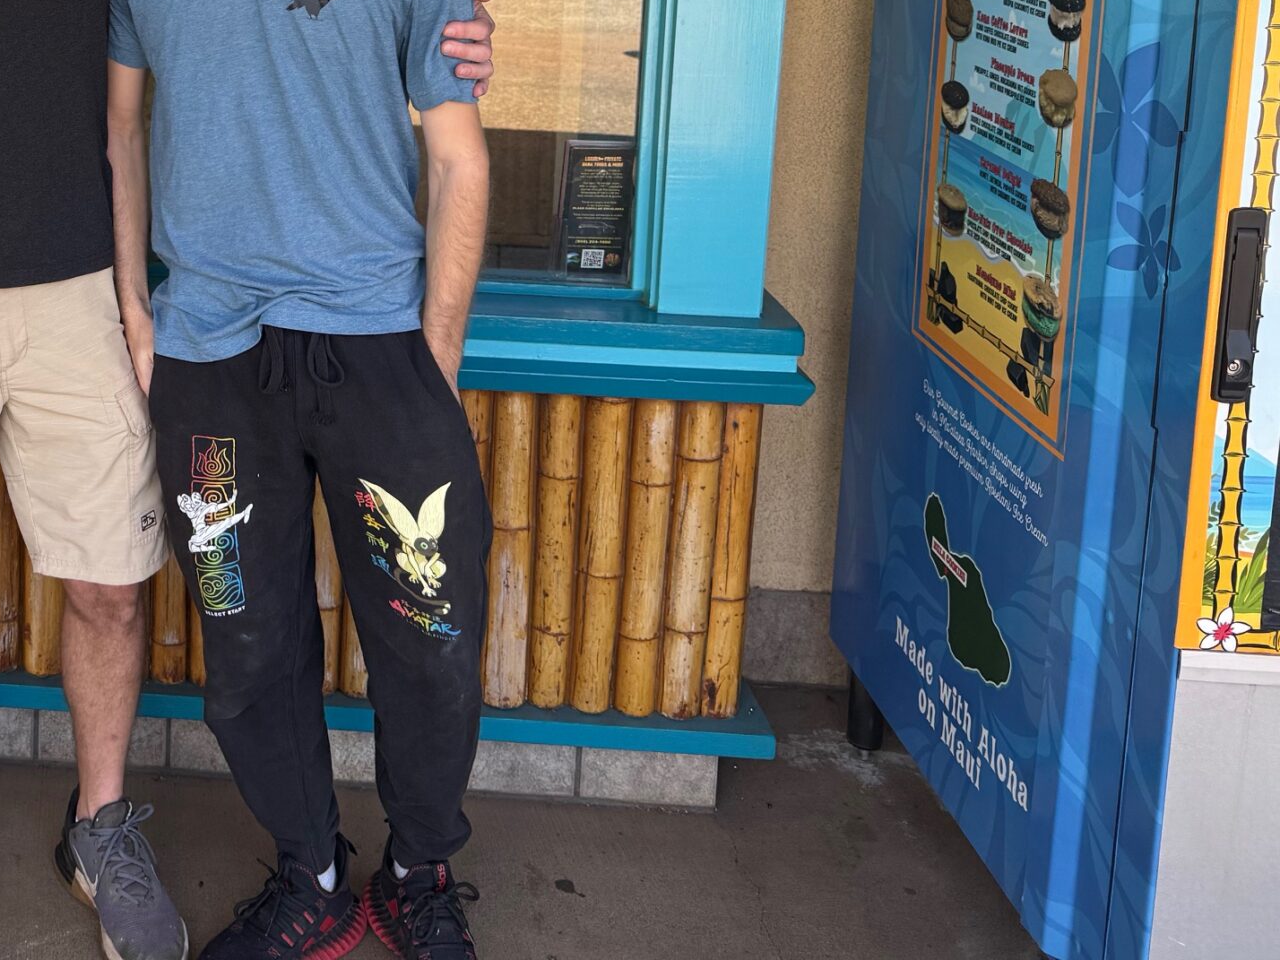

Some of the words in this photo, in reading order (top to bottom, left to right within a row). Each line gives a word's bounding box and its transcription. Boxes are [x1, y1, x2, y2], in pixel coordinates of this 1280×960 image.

[923, 379, 934, 398] Our
[936, 390, 959, 420] Gourmet
[960, 412, 980, 440] Cookies
[981, 435, 992, 451] are
[992, 442, 1024, 481] handmade
[1025, 472, 1043, 498] fresh
[966, 439, 989, 469] Harbor
[1009, 484, 1028, 509] using
[943, 441, 959, 461] made
[959, 454, 984, 485] premium
[1013, 503, 1024, 524] Ice
[1026, 514, 1048, 547] Cream
[895, 615, 934, 685] Made
[938, 675, 972, 742] with
[977, 723, 1028, 812] Aloha
[918, 688, 936, 730] on
[940, 711, 983, 791] Maui
